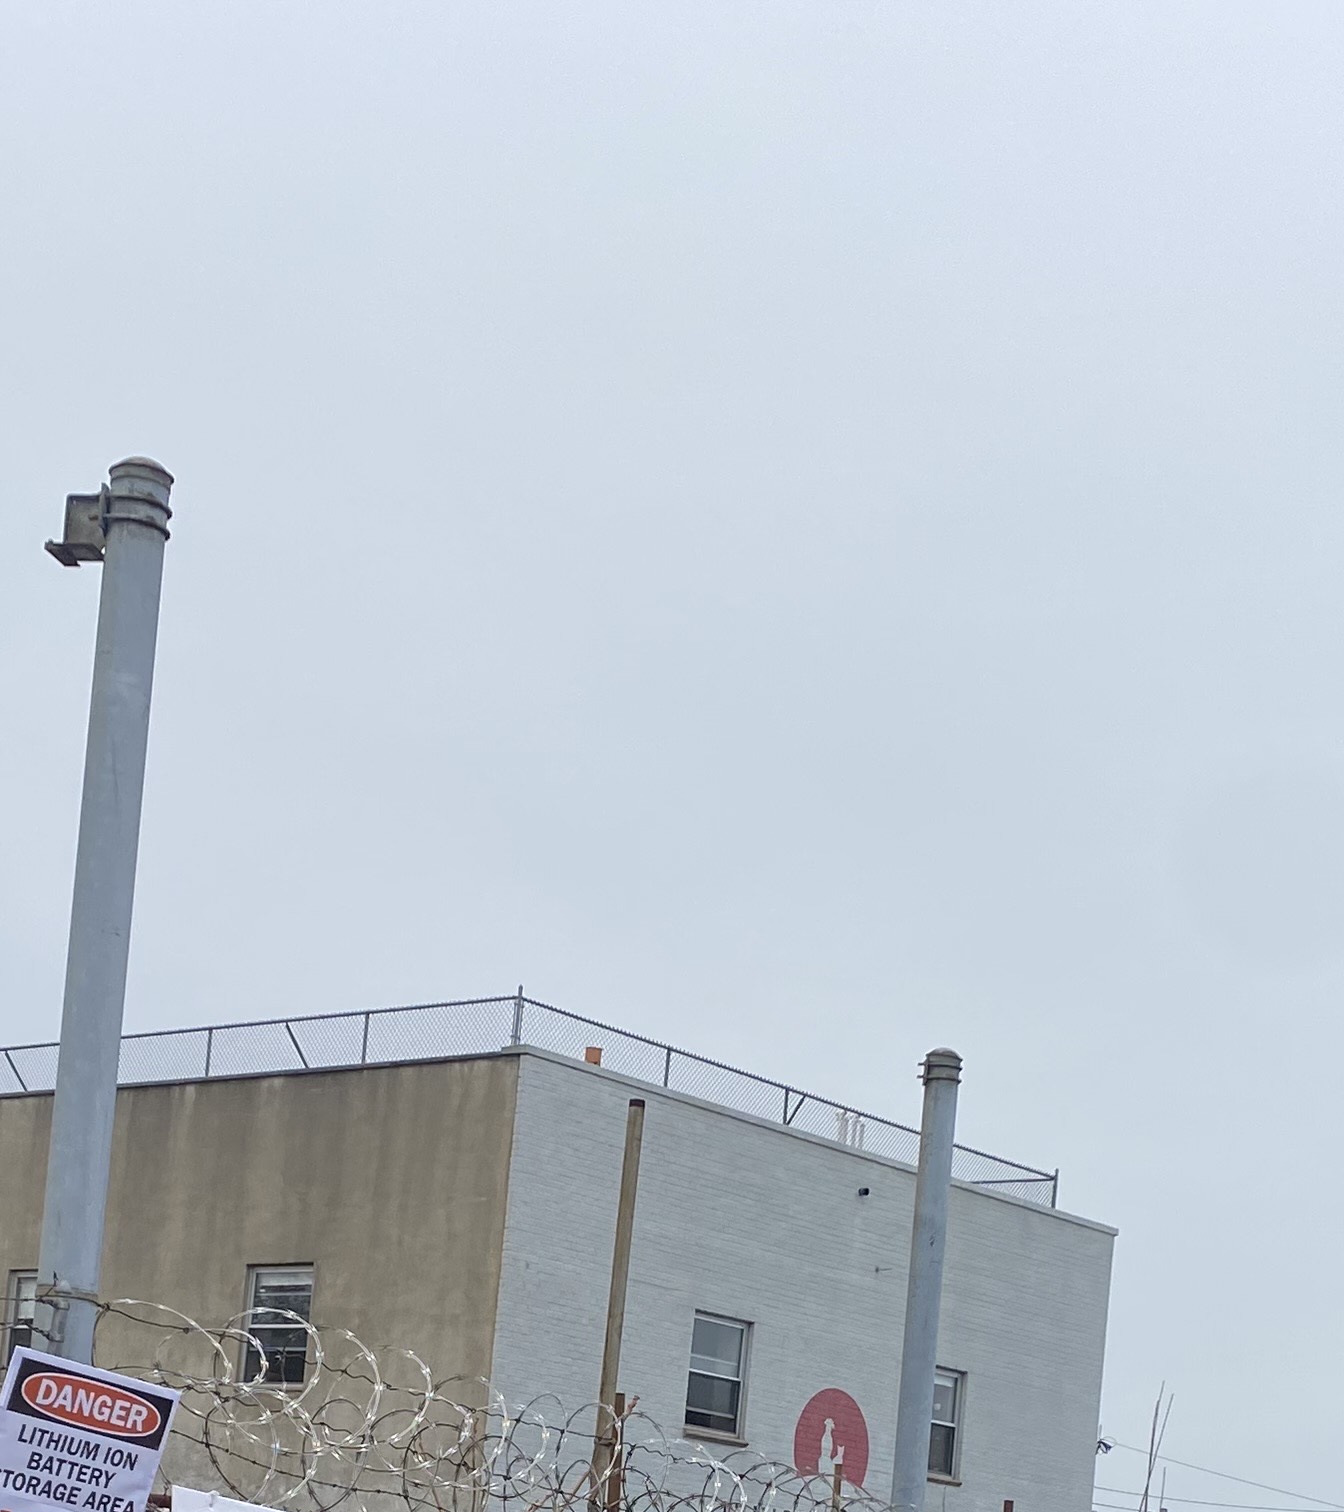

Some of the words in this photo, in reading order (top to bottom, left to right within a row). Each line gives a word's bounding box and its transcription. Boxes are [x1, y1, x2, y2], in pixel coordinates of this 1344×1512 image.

[35, 1378, 149, 1432] DANGER
[17, 1424, 101, 1462] LITHIUM
[105, 1446, 138, 1472] ION
[27, 1451, 116, 1489] BATTERY
